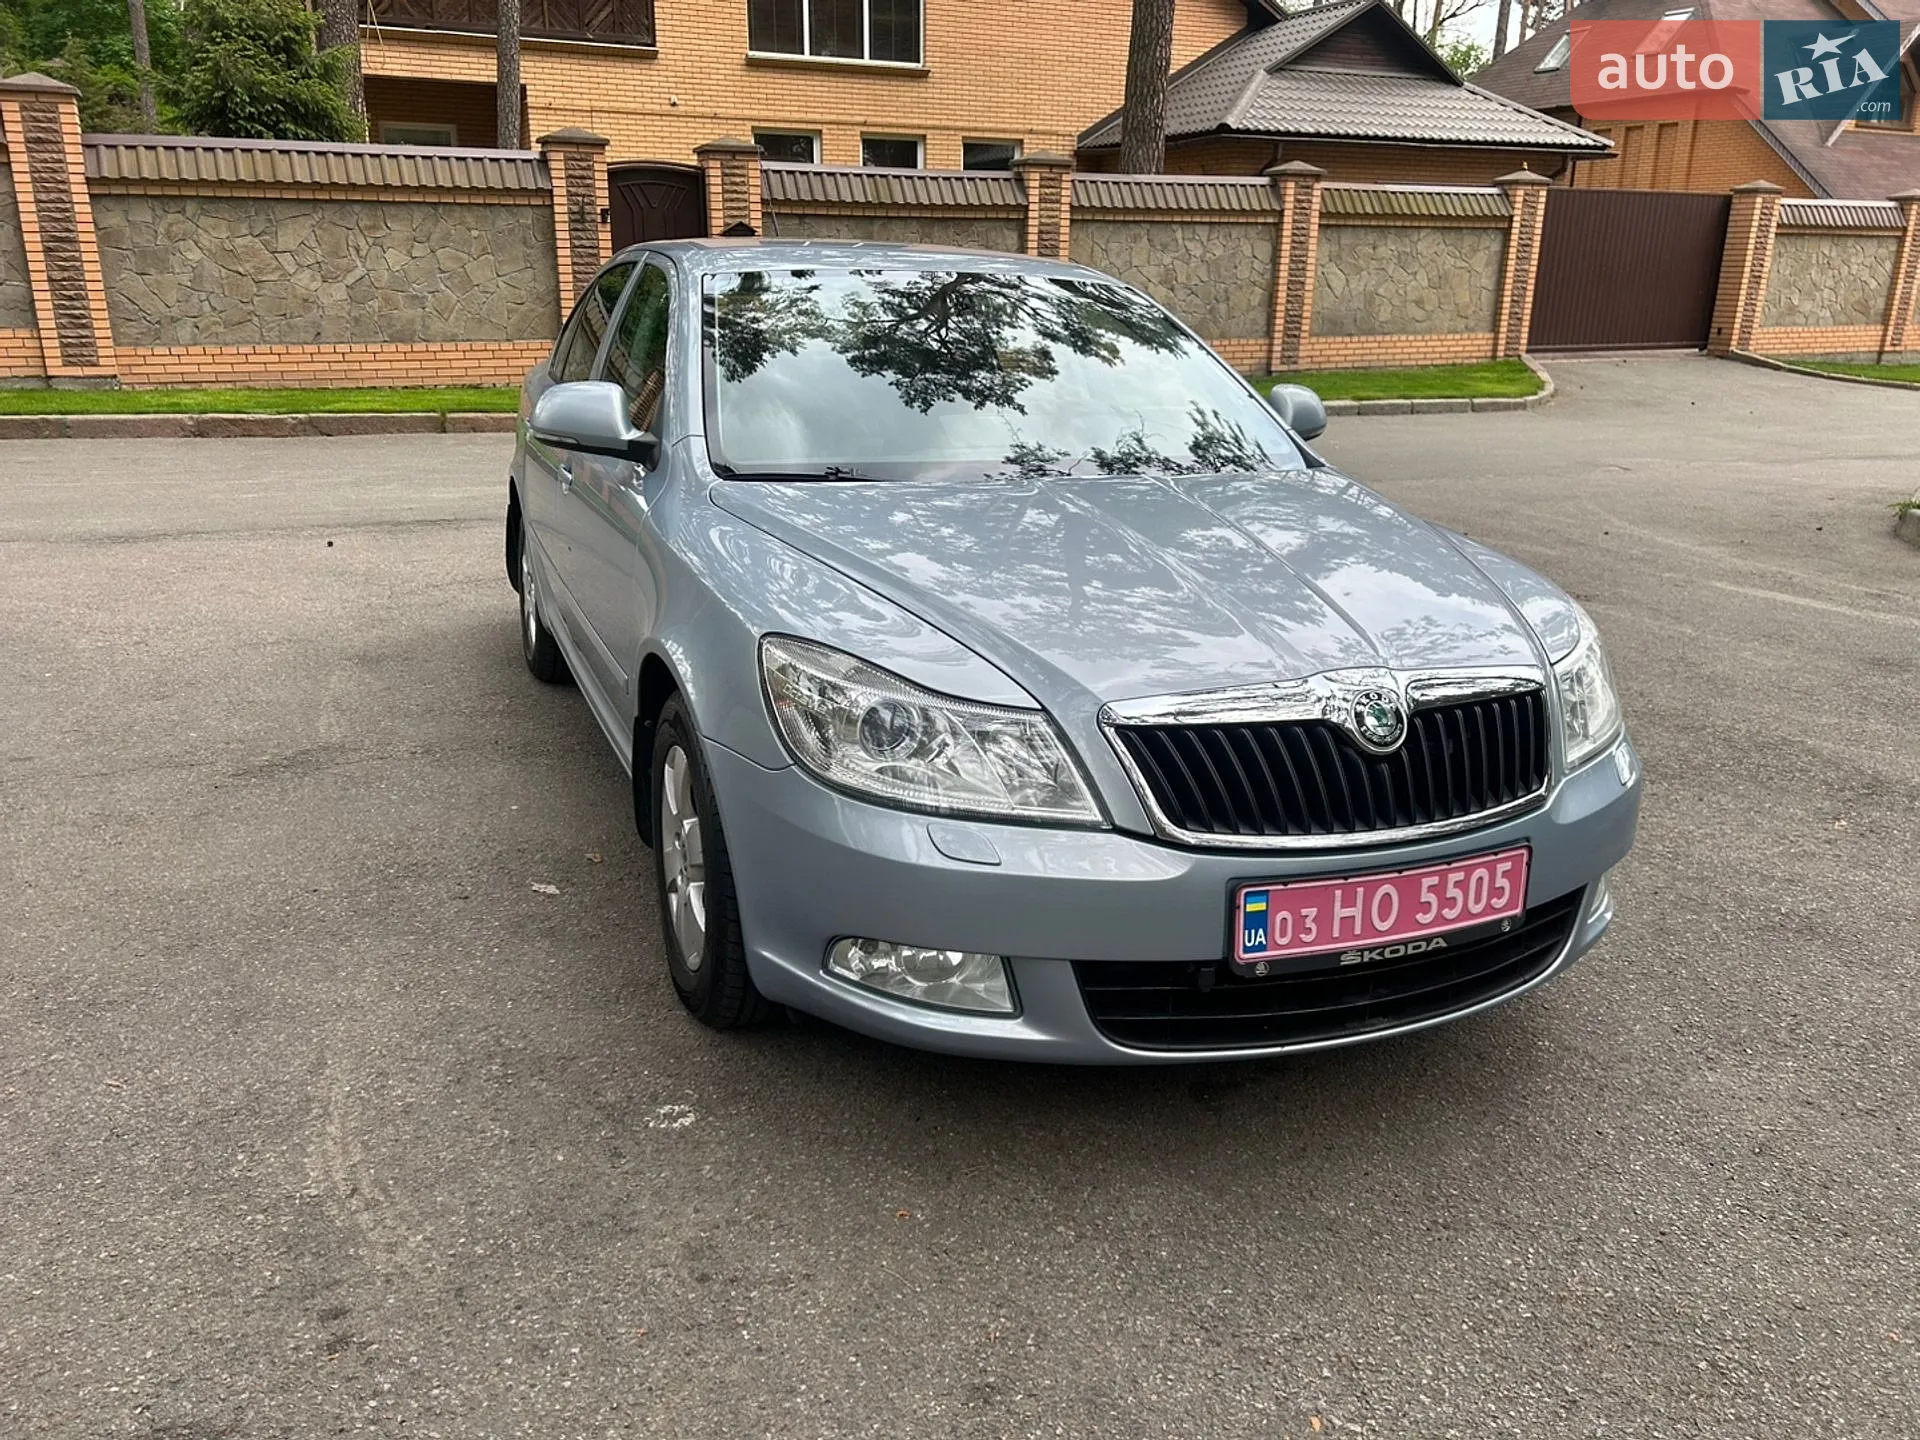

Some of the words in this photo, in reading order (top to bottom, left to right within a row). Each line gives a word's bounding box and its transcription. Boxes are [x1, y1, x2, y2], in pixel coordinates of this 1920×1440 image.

[1274, 907, 1318, 946] 03
[1332, 884, 1399, 938] HO
[1415, 861, 1512, 925] 5505
[1244, 928, 1267, 947] UA
[1340, 937, 1448, 966] ŠKODA
